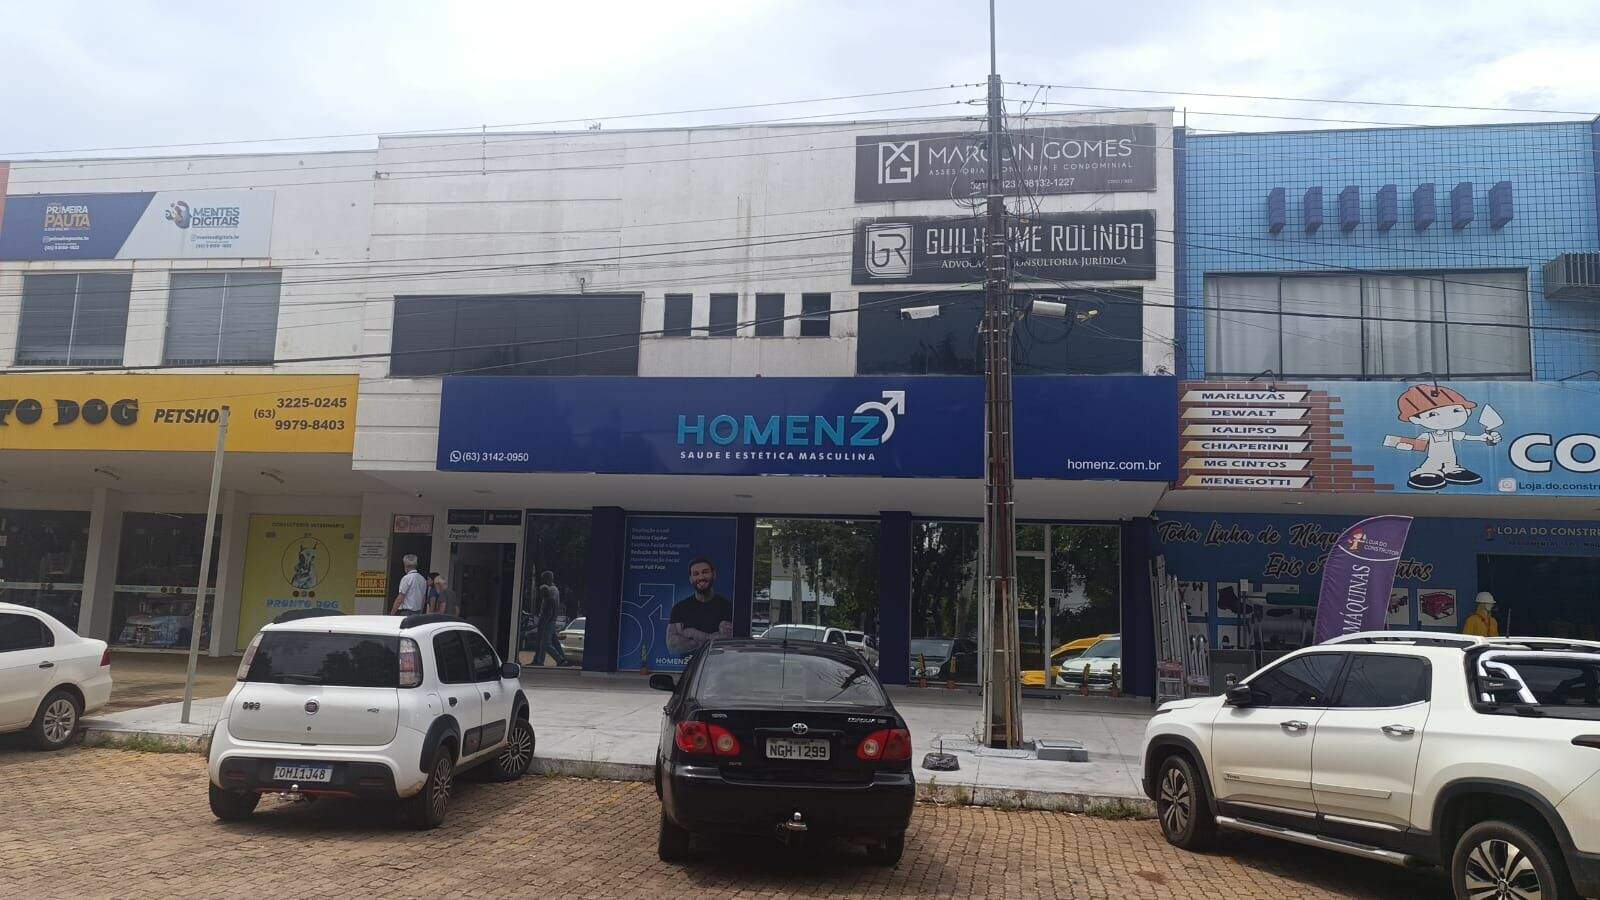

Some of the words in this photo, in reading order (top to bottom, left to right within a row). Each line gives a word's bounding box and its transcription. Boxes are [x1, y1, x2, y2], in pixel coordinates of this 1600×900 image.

[1044, 139, 1132, 159] GOMES
[929, 168, 987, 177] ASSESORIA
[192, 207, 240, 217] MENTES
[44, 214, 91, 228] PAUTA
[192, 217, 239, 226] DIGITAIS
[926, 227, 1042, 255] GUILHME
[1051, 223, 1144, 251] ROLINDO
[1014, 257, 1078, 268] ONSULTORIA
[276, 397, 347, 408] 3225-0245
[1201, 393, 1286, 401] MARLUVAS
[53, 398, 140, 426] DOG
[253, 408, 276, 420] (63)
[1211, 409, 1277, 418] DEWALT
[275, 420, 345, 431] 9979-8403
[677, 413, 881, 447] HOMENZ
[1212, 426, 1278, 435] KALIPSO
[1201, 443, 1289, 452] CHIAPERINI
[462, 452, 480, 463] (63)
[482, 452, 530, 462] 3142-0950
[725, 452, 732, 460] E
[798, 452, 876, 462] MASCULINA
[1508, 433, 1600, 474] CO
[1067, 458, 1162, 472] homenz.com.br
[1203, 460, 1228, 468] MG
[1231, 461, 1287, 469] CINTOS
[1200, 477, 1291, 487] MENEGOTTI
[1518, 481, 1600, 491] Loja.do.constr
[1157, 520, 1200, 547] Toda
[1204, 519, 1252, 547] Linha
[1256, 523, 1281, 545] de
[1288, 522, 1342, 552] Máqu
[1498, 527, 1527, 535] LOJA
[1530, 527, 1548, 535] DO
